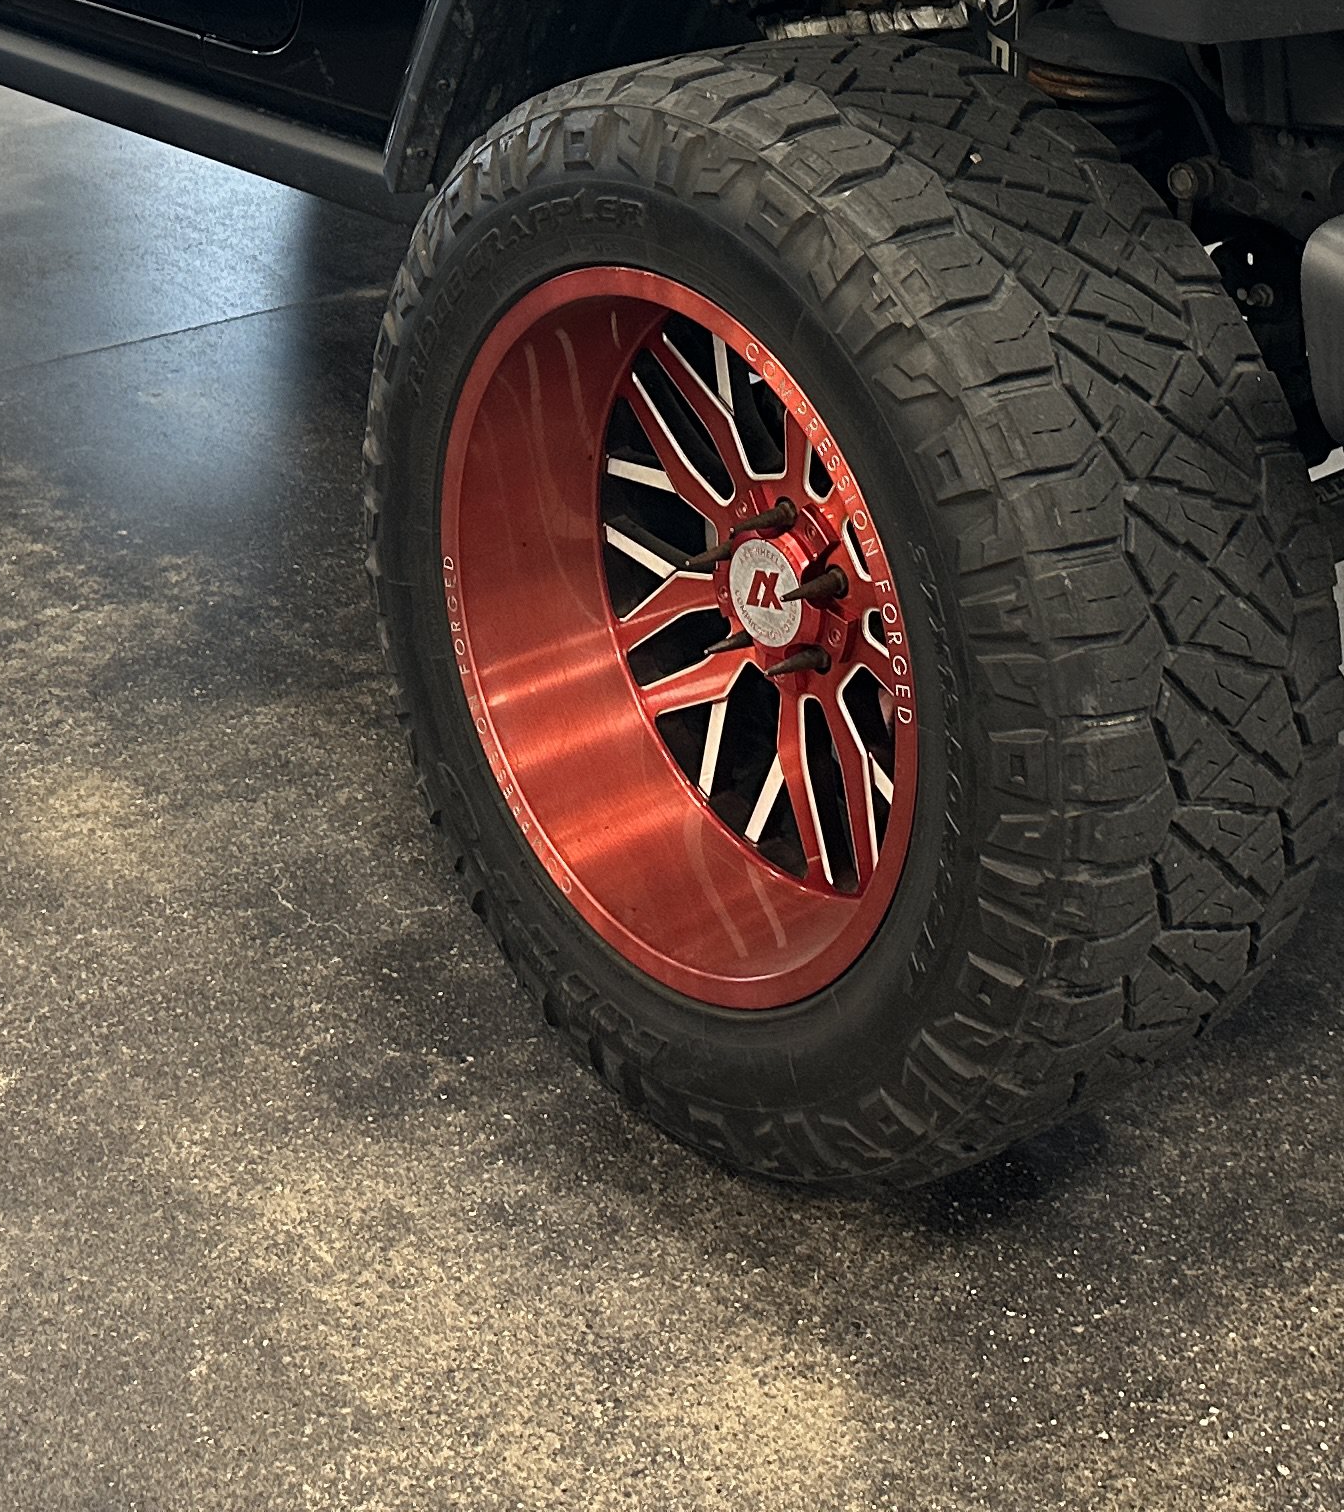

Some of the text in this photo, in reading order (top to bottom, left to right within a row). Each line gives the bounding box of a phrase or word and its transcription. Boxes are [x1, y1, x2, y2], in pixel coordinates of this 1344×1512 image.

[443, 555, 472, 675] FORGED
[744, 341, 913, 726] COMPRESSION FORGED
